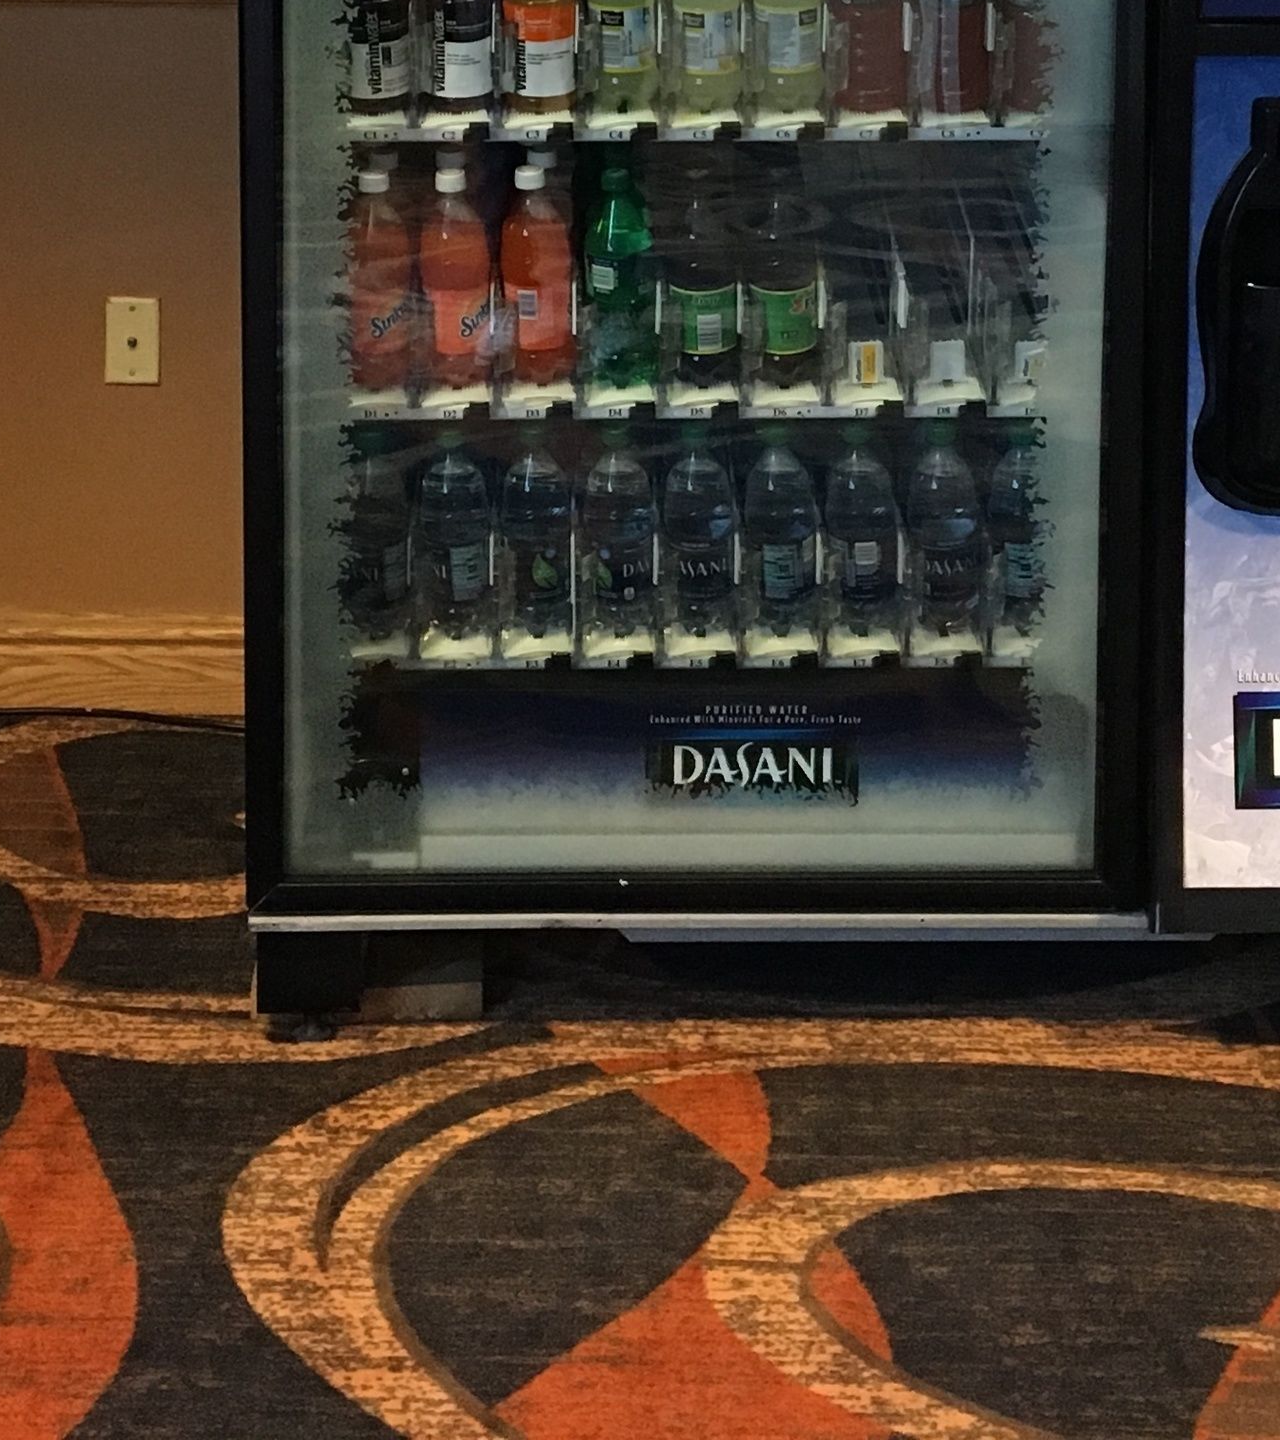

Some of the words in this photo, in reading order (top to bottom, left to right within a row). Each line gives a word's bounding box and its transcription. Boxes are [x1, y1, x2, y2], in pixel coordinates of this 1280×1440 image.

[363, 130, 377, 140] C1
[442, 131, 455, 140] C2
[526, 130, 540, 140] C3
[609, 131, 623, 139] C4
[693, 130, 707, 139] C5
[776, 130, 790, 139] C6
[859, 130, 873, 138] C7
[941, 130, 955, 138] C8
[705, 704, 762, 715] PURIFIED
[768, 704, 808, 715] WATER
[693, 714, 715, 724] With
[672, 741, 833, 787] DASANI
